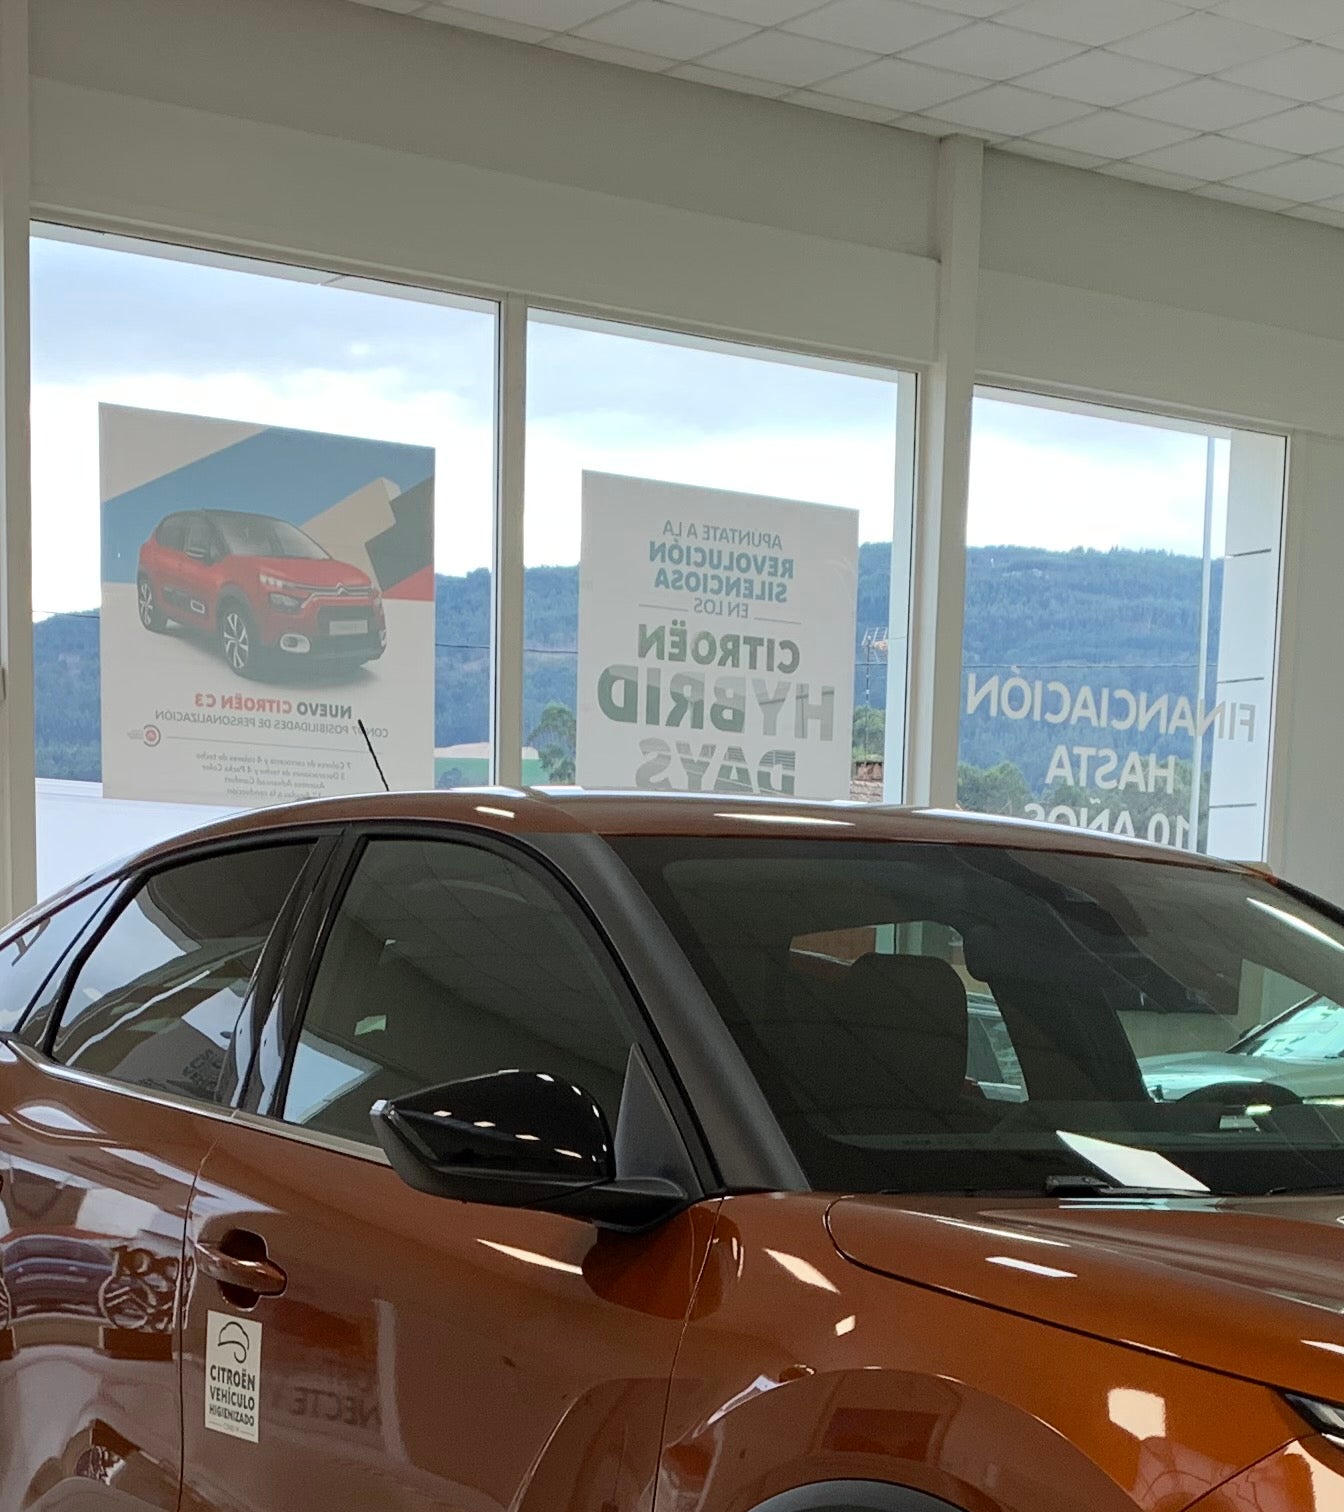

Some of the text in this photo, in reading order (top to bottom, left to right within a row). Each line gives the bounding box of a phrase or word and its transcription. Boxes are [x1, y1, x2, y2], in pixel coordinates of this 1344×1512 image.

[210, 1364, 255, 1392] CITROËN
[210, 1385, 255, 1411] VEHÍCULO
[209, 1404, 254, 1427] HIGIENIZADO
